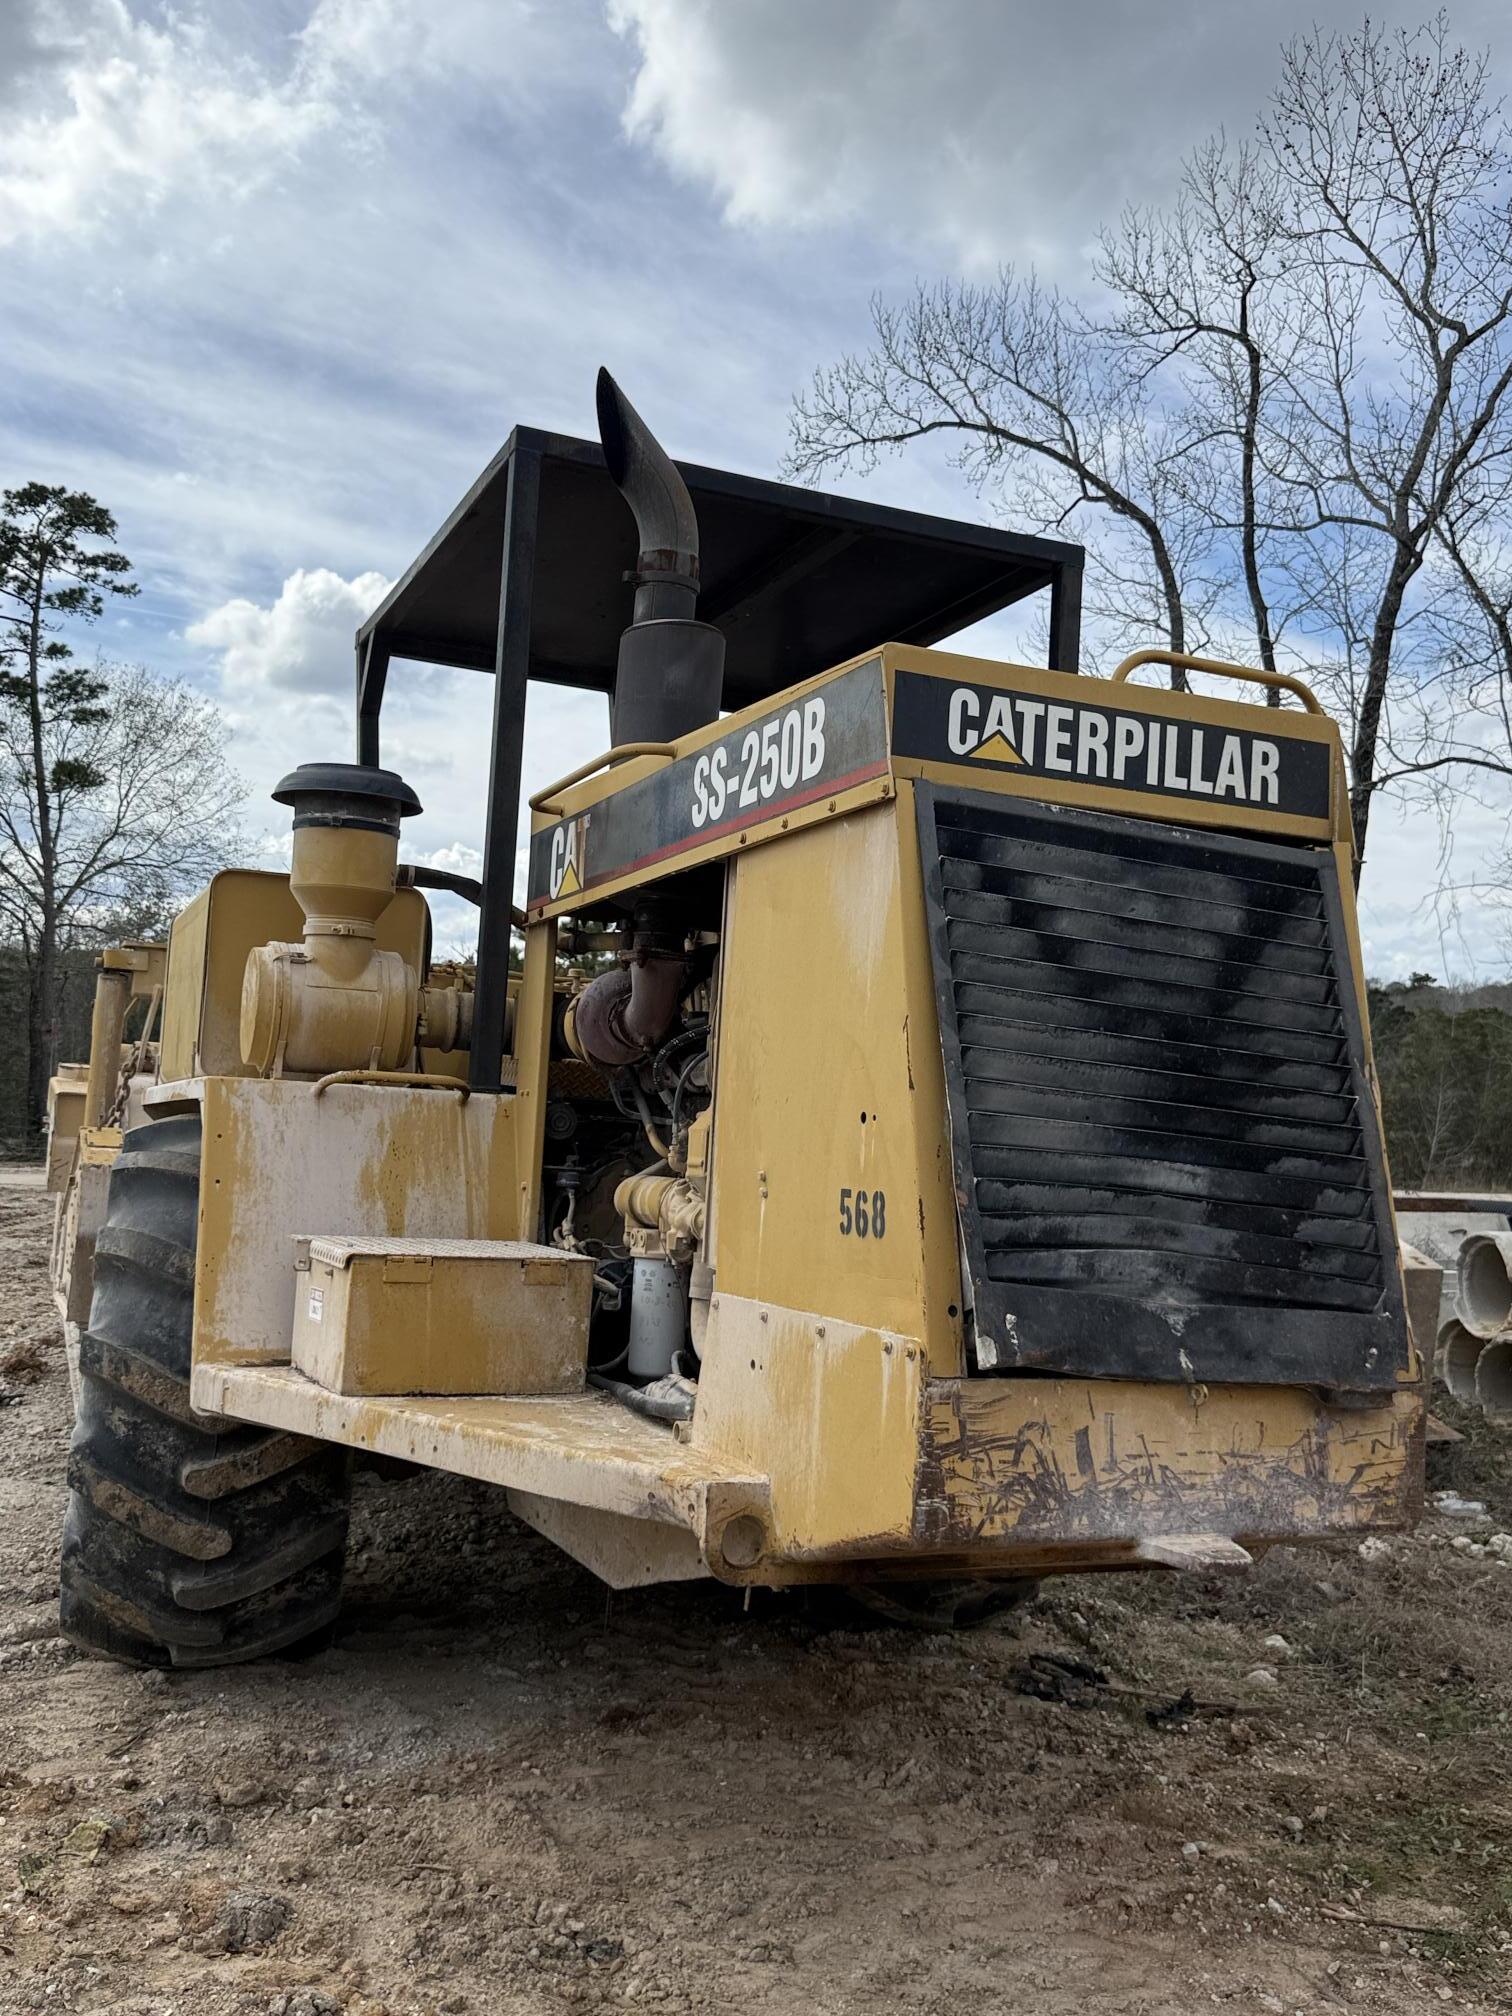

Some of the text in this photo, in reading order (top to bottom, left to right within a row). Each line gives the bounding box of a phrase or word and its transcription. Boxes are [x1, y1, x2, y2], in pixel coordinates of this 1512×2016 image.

[691, 697, 826, 828] SS-250B
[946, 688, 1281, 804] CATERPILLAR
[549, 813, 591, 900] CAT
[839, 1188, 886, 1239] 568
